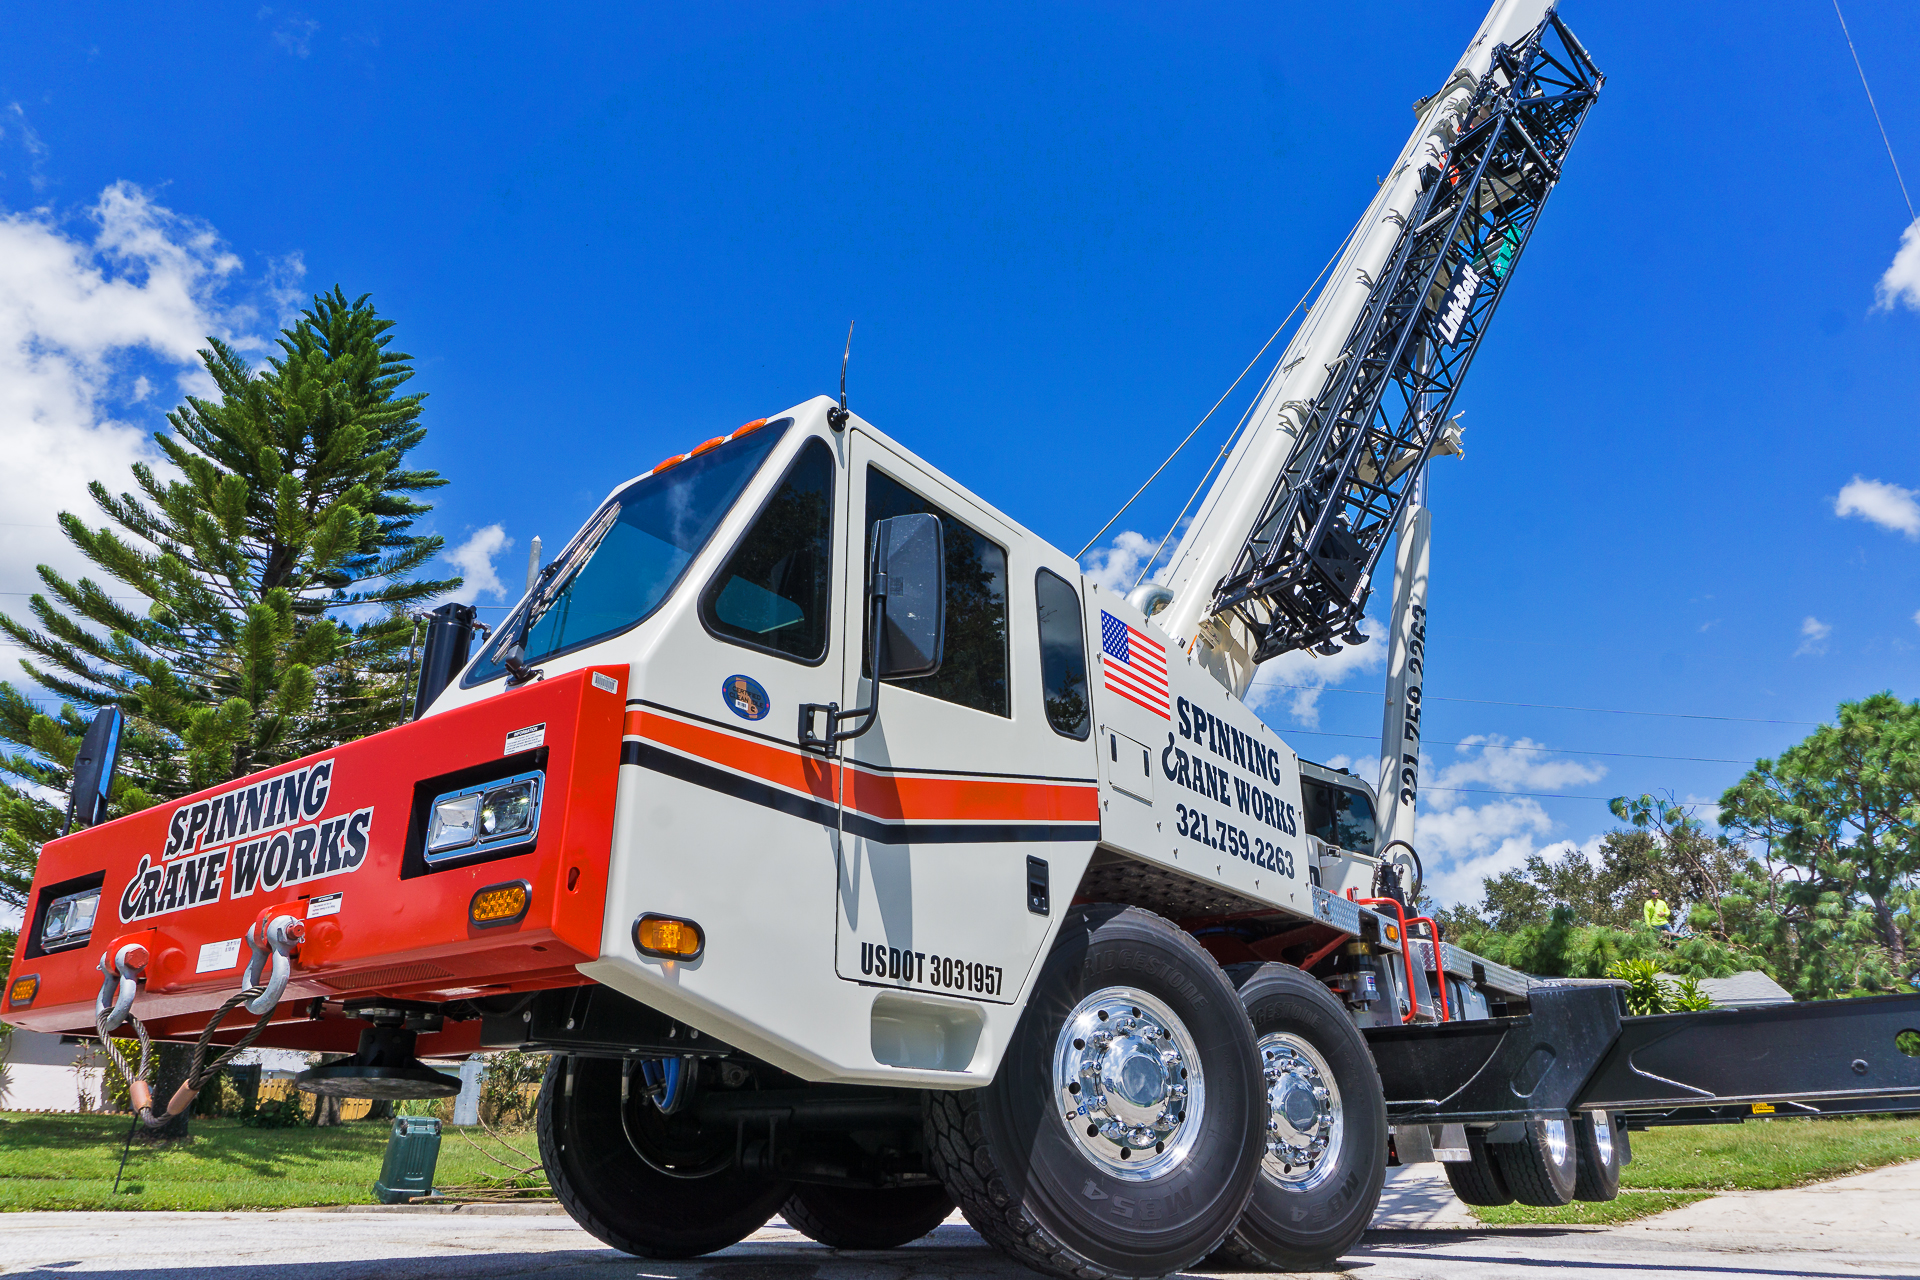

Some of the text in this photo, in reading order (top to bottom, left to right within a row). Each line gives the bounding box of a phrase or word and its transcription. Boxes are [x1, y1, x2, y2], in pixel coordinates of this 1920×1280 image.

[1438, 264, 1480, 344] Link-Belt
[1176, 695, 1280, 786] SPINNING
[163, 760, 334, 860] SPINNING
[1175, 803, 1295, 880] 321.759.2263
[1233, 775, 1297, 838] WORKS
[231, 806, 374, 899] WORKS
[861, 941, 1003, 996] USDOT 3031957
[1070, 949, 1209, 1012] RIDGESTONE
[1081, 1178, 1194, 1221] M854
